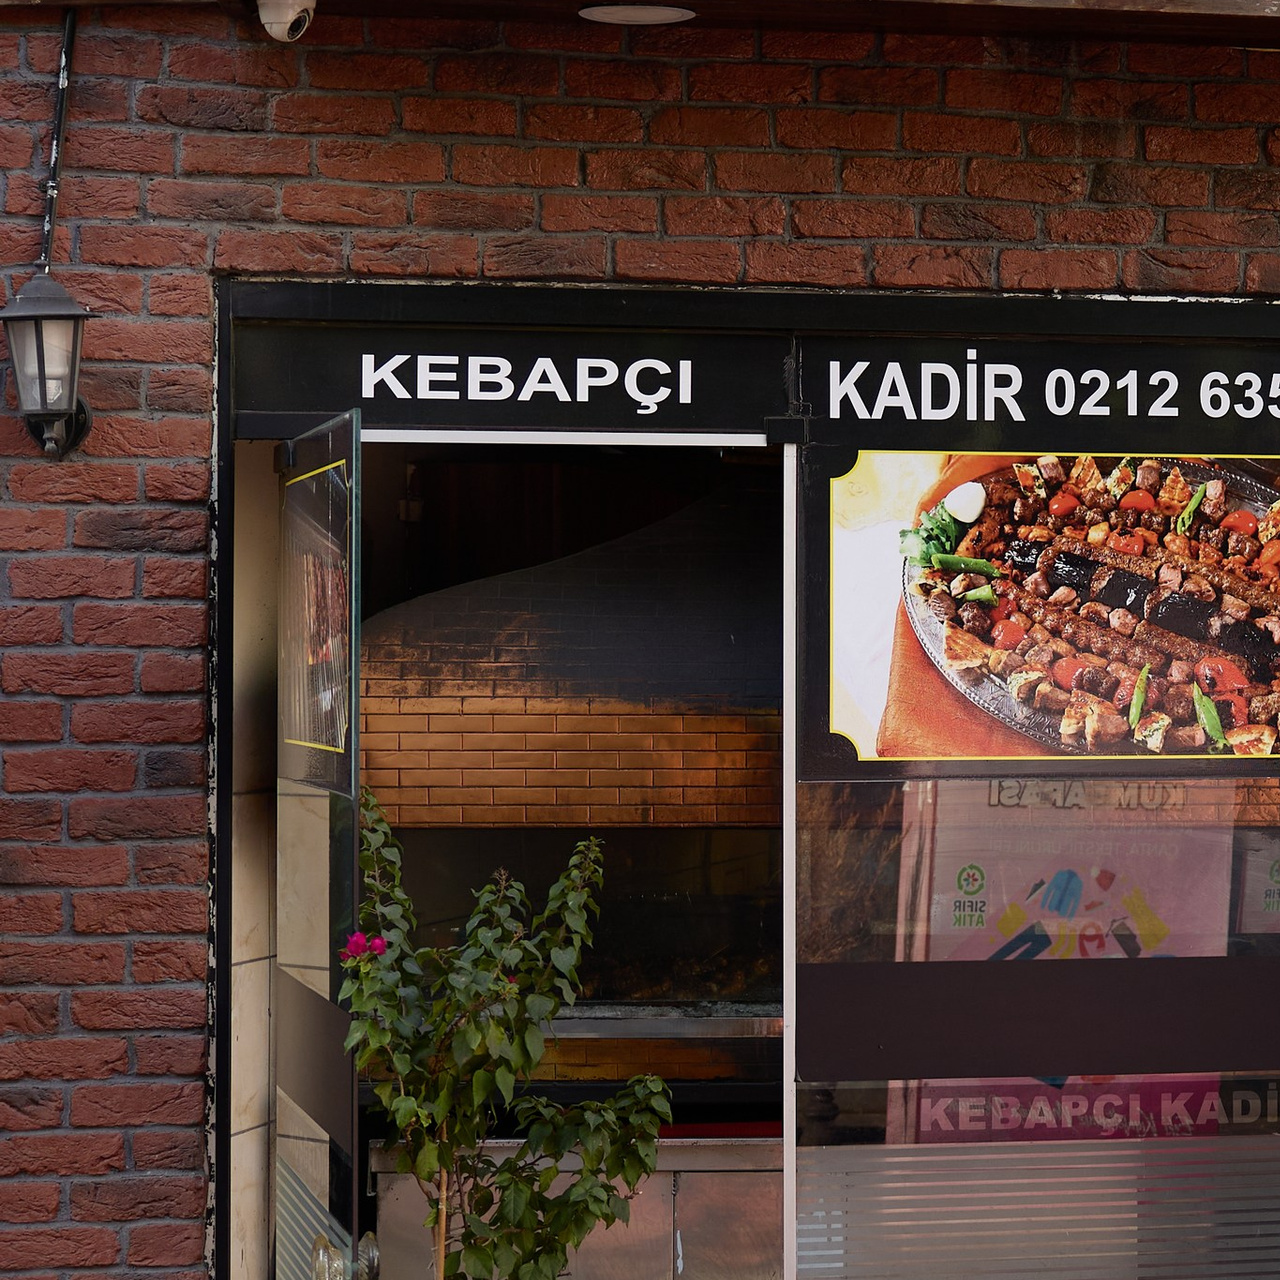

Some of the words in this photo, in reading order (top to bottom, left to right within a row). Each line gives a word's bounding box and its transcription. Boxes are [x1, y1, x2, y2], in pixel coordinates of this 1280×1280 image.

[361, 353, 693, 414] KEBAPÇI
[828, 348, 1027, 424] KADİR
[1045, 368, 1181, 420] 0212
[921, 1091, 1142, 1138] KEBAPÇI
